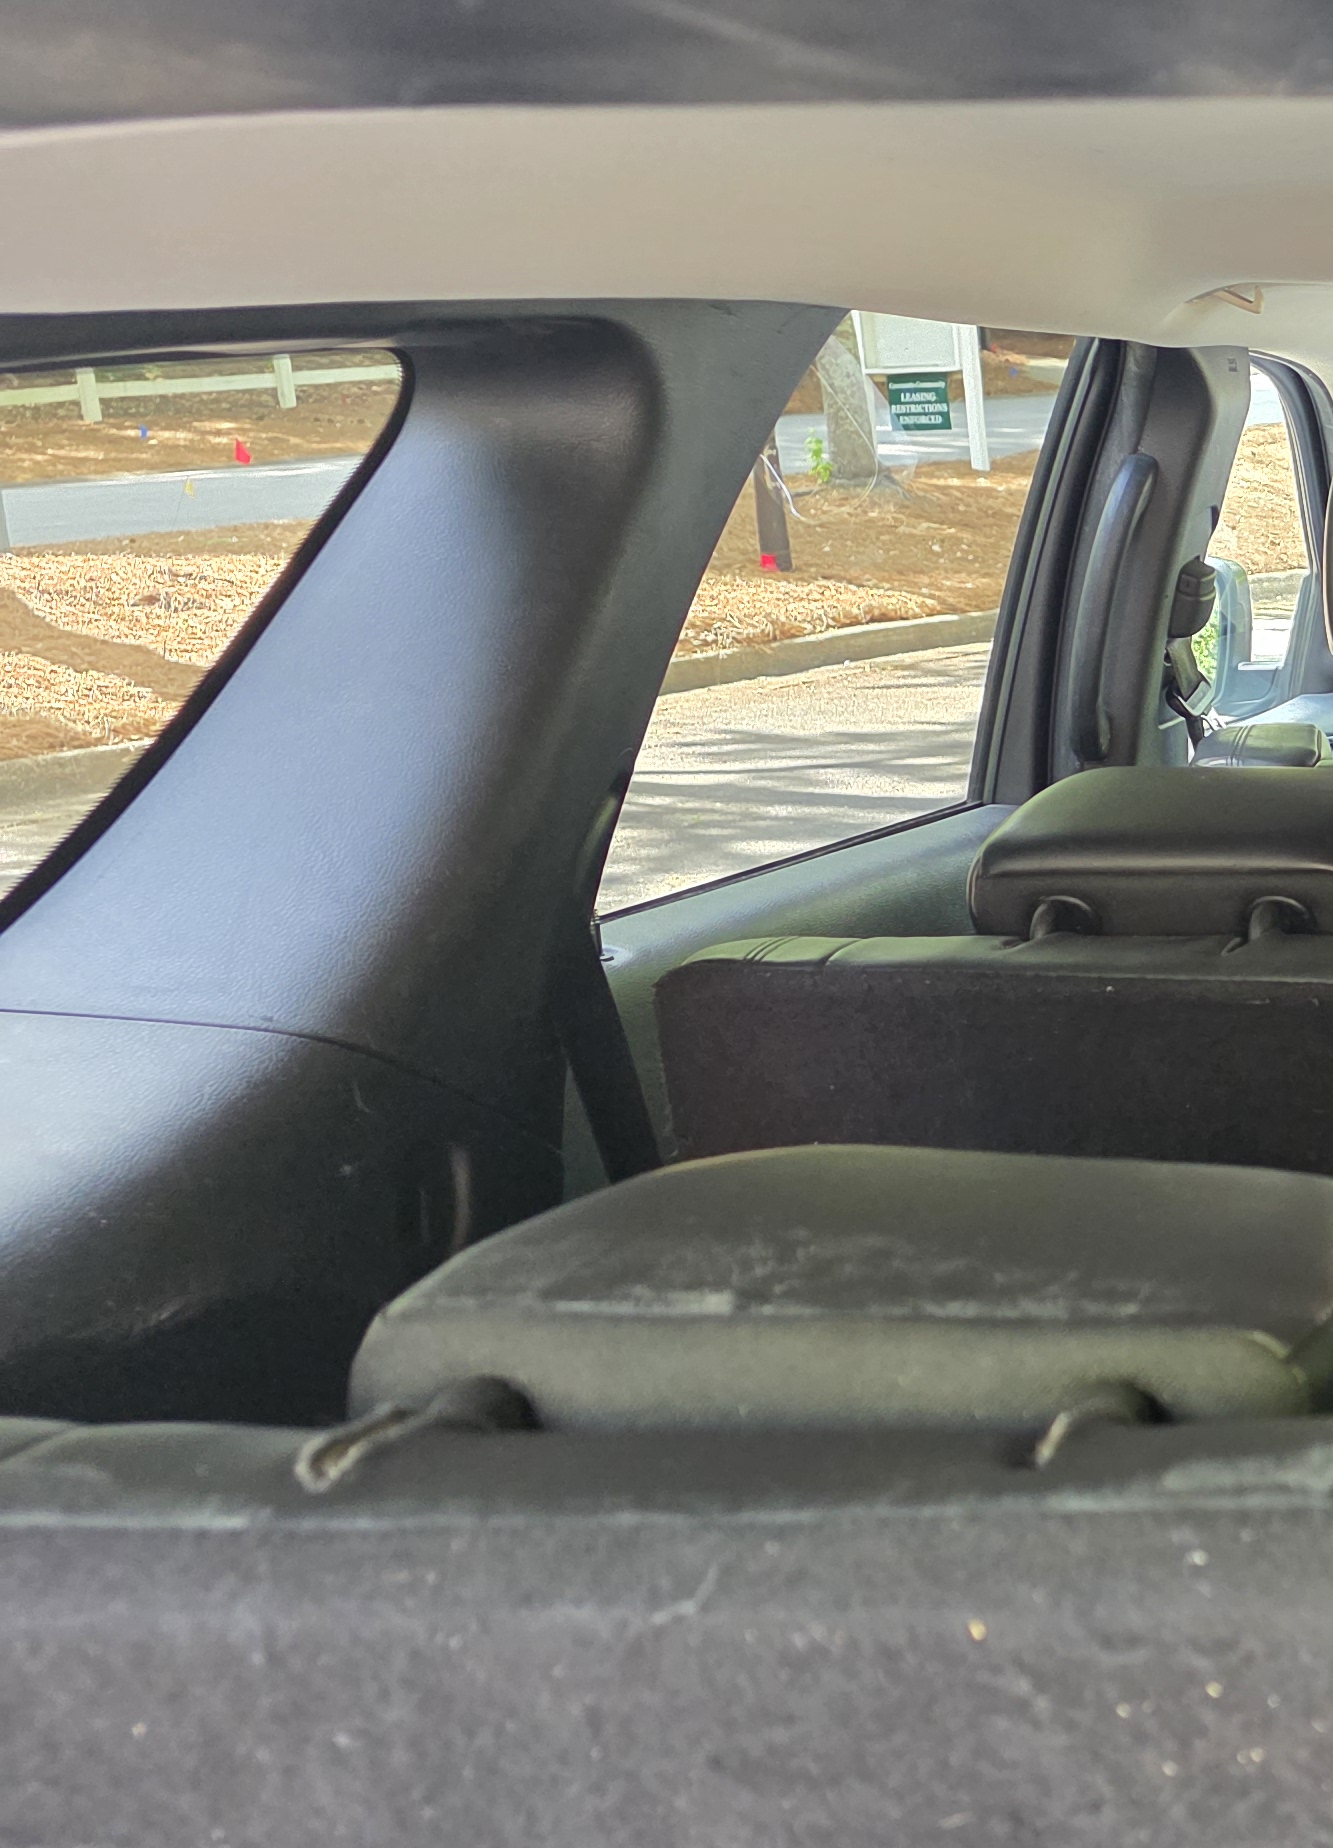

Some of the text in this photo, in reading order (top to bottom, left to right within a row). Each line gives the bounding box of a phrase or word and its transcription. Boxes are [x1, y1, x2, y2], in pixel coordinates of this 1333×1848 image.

[901, 392, 936, 402] LEASING
[891, 403, 948, 414] RESTRICTIONS
[900, 414, 942, 425] ENFORCED
